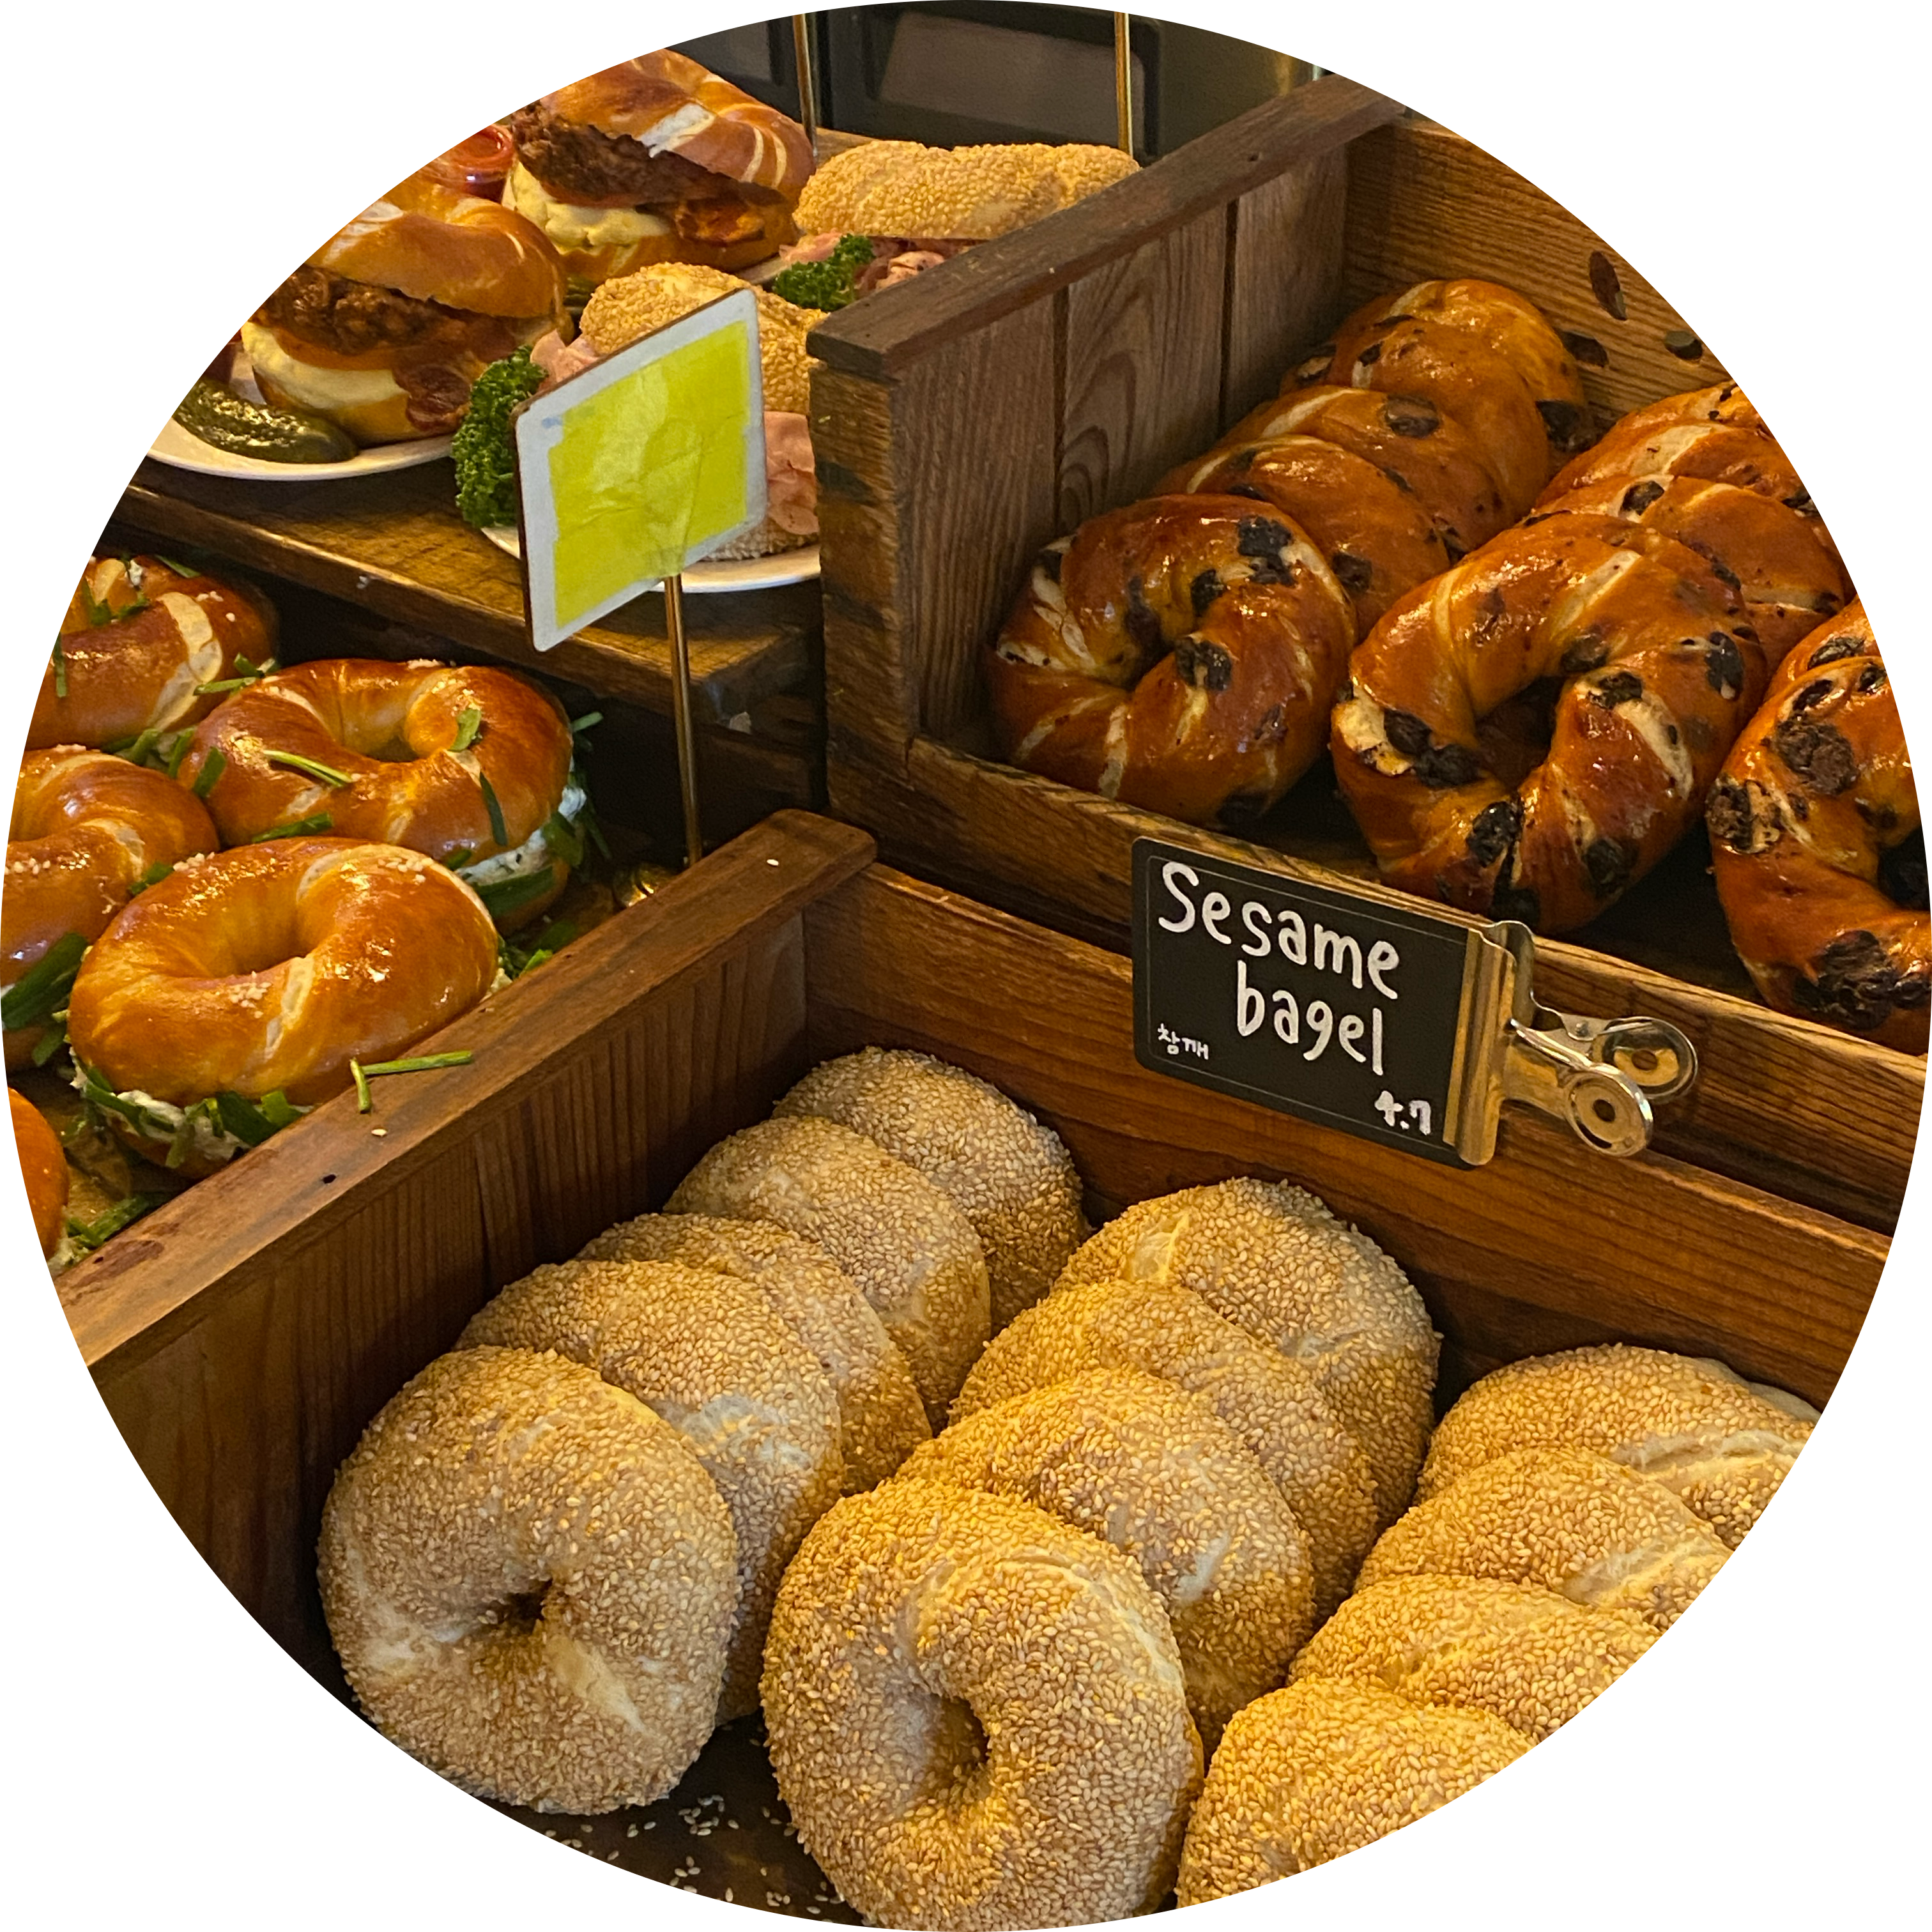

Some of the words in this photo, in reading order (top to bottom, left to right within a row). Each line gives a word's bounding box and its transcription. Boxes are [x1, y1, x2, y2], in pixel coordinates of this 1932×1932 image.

[1158, 861, 1400, 1000] Sesame
[1157, 1023, 1209, 1060] 참깨
[1237, 960, 1384, 1077] bagel
[1374, 1090, 1431, 1135] 4.7
